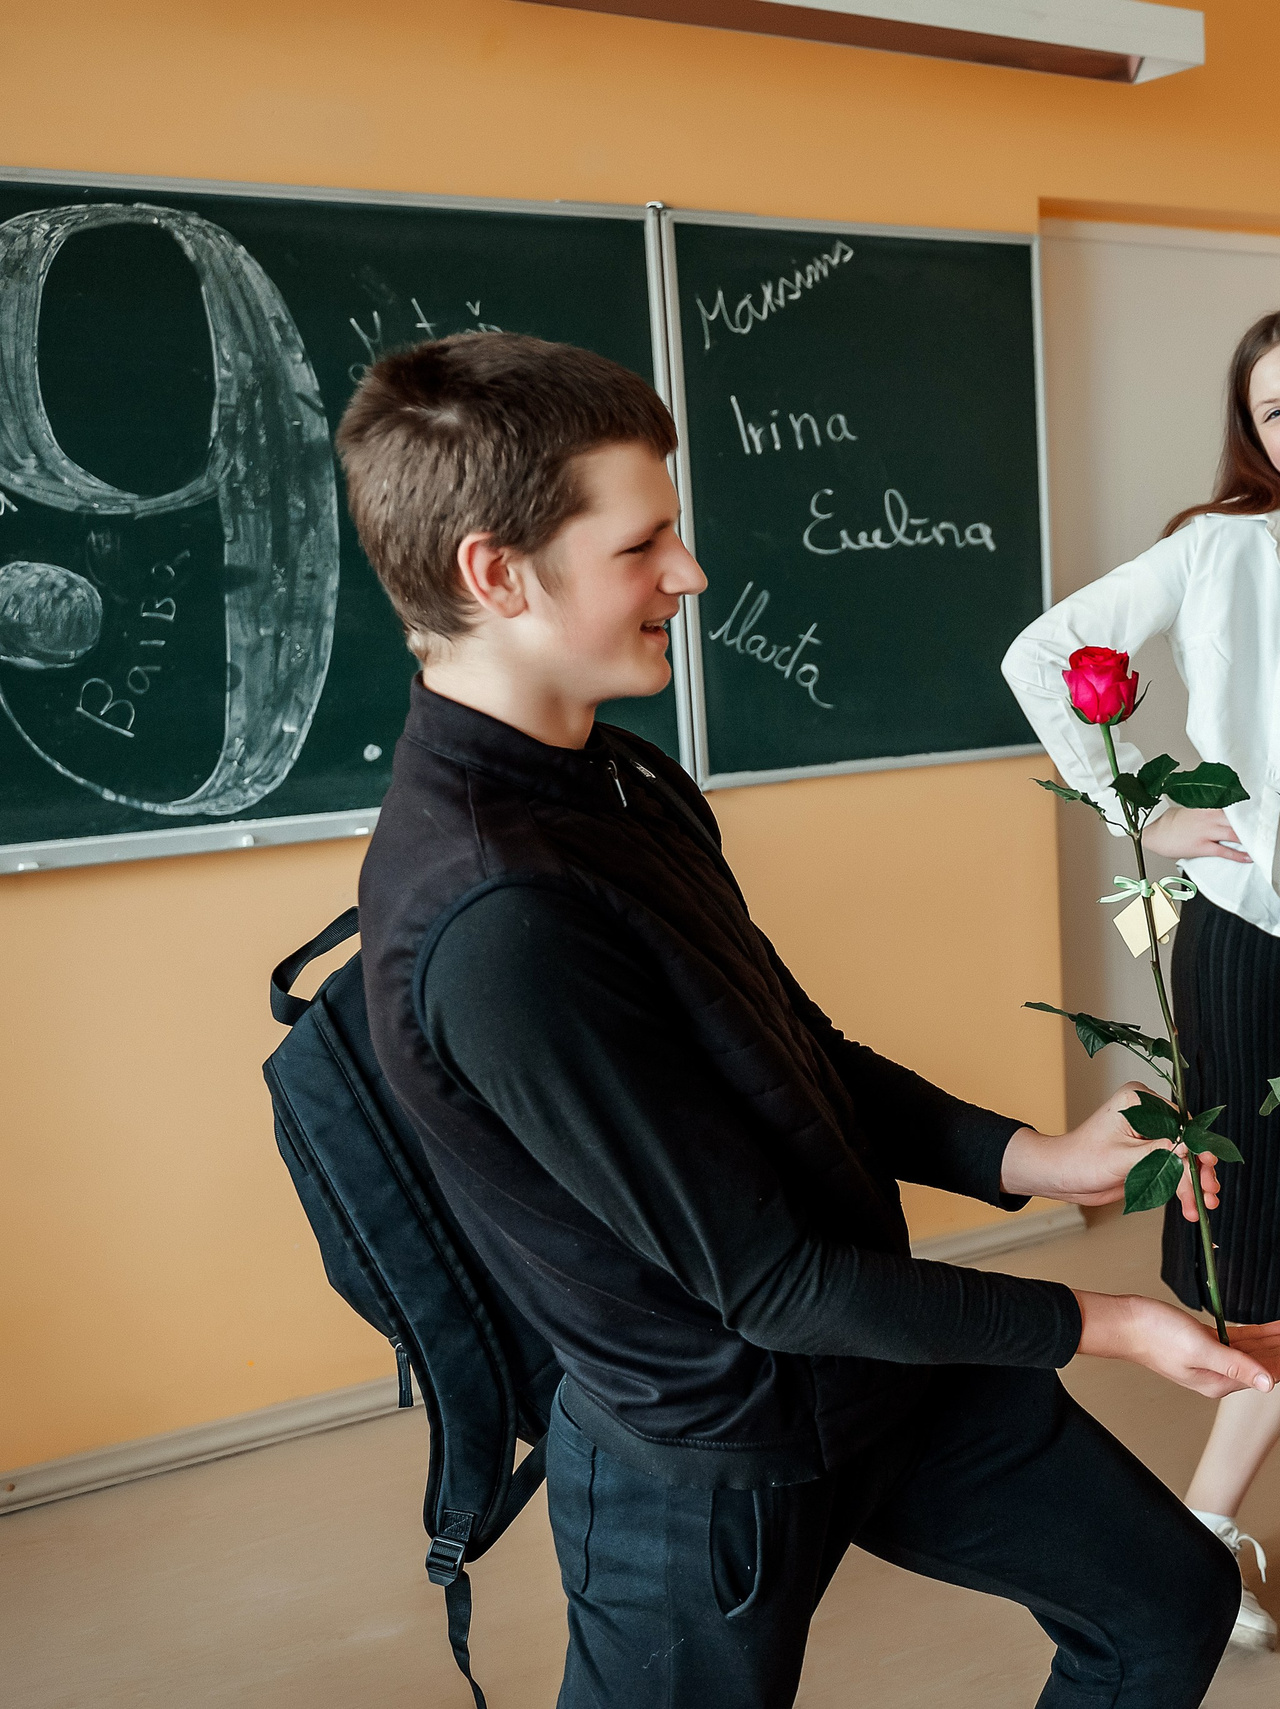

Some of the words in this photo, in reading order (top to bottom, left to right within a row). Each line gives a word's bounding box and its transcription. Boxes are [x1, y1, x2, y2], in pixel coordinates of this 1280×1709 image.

[695, 240, 854, 350] Maksims
[730, 395, 858, 455] Irina
[708, 581, 834, 709] Marta
